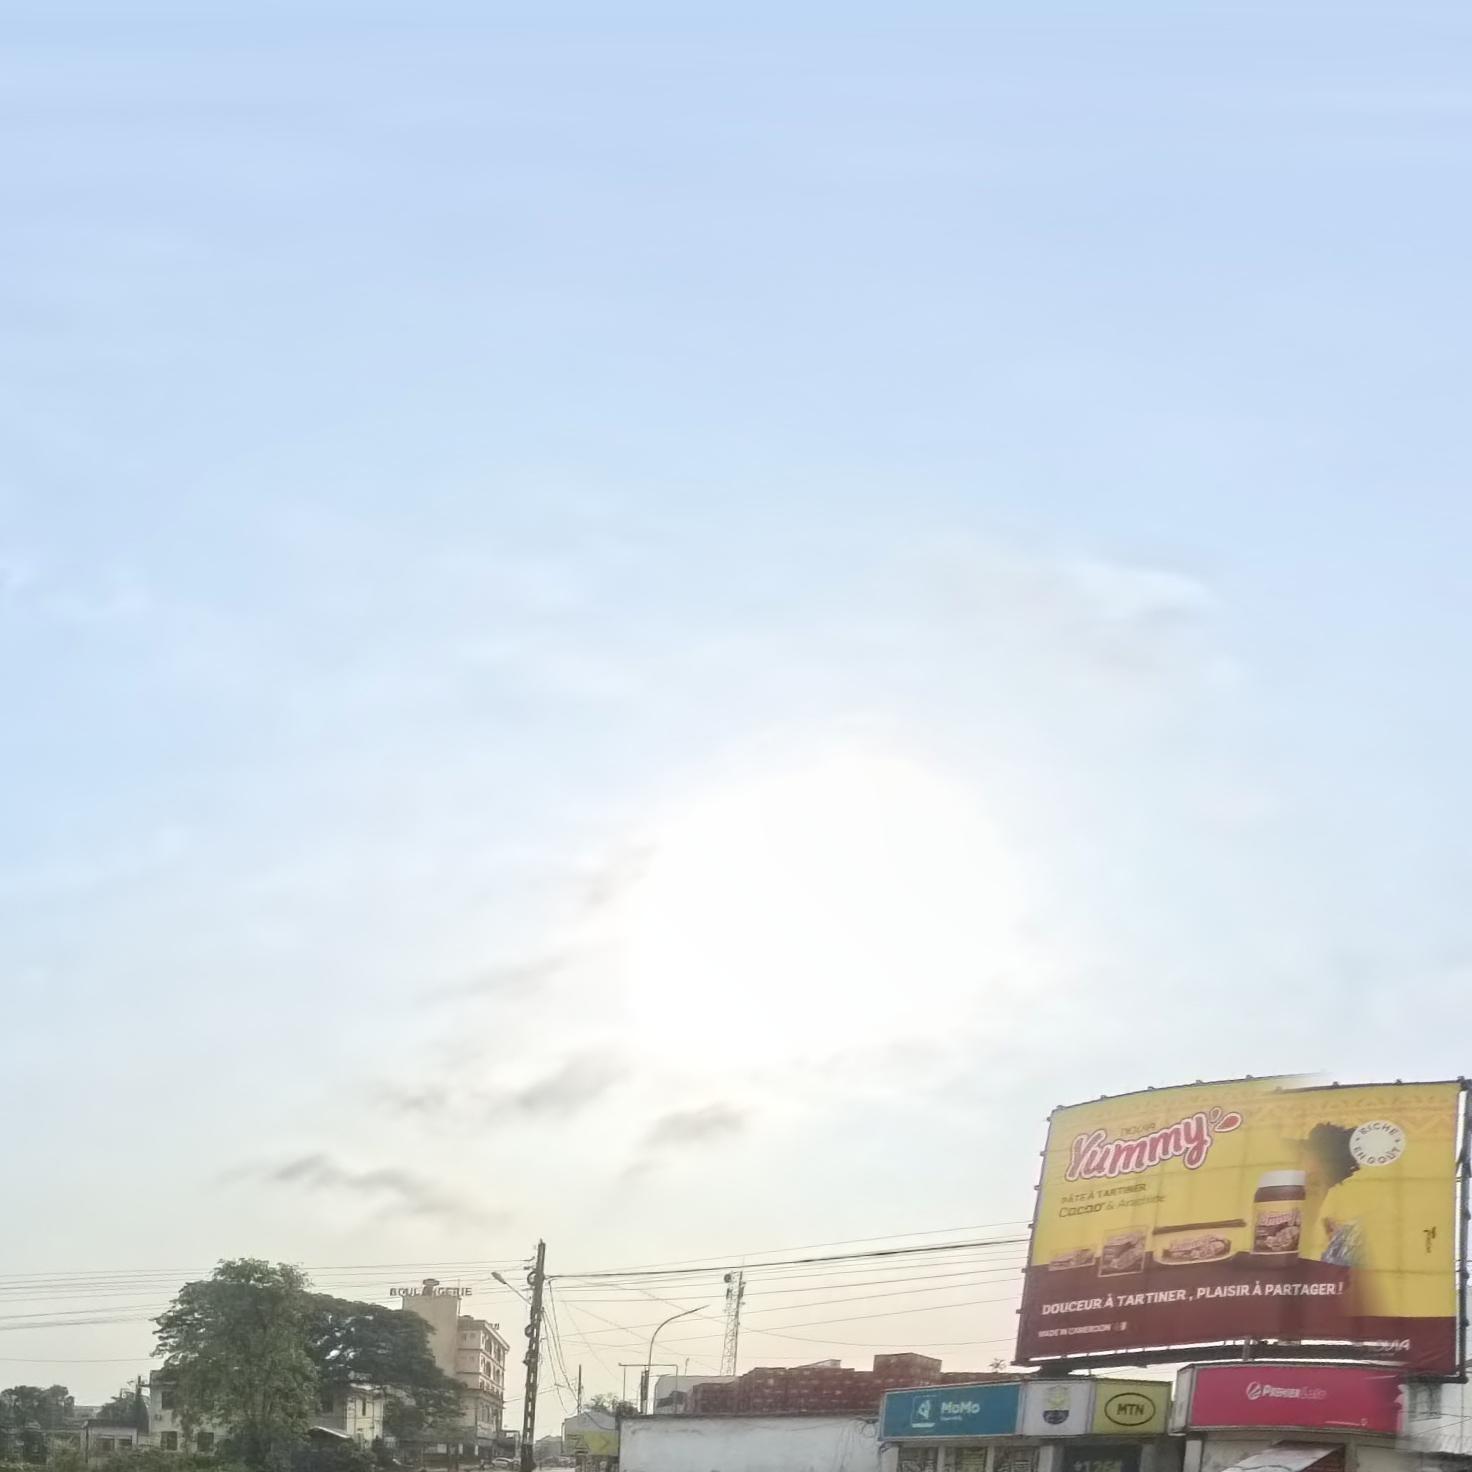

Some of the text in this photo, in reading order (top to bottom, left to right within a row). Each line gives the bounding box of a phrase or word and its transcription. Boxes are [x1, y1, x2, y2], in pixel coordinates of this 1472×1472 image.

[1065, 1112, 1212, 1181] Yummy
[1042, 1298, 1103, 1315] DOUCEUR
[1197, 1284, 1249, 1299] PLAISIR
[940, 1400, 980, 1415] MoMo
[1116, 1403, 1144, 1416] MTN
